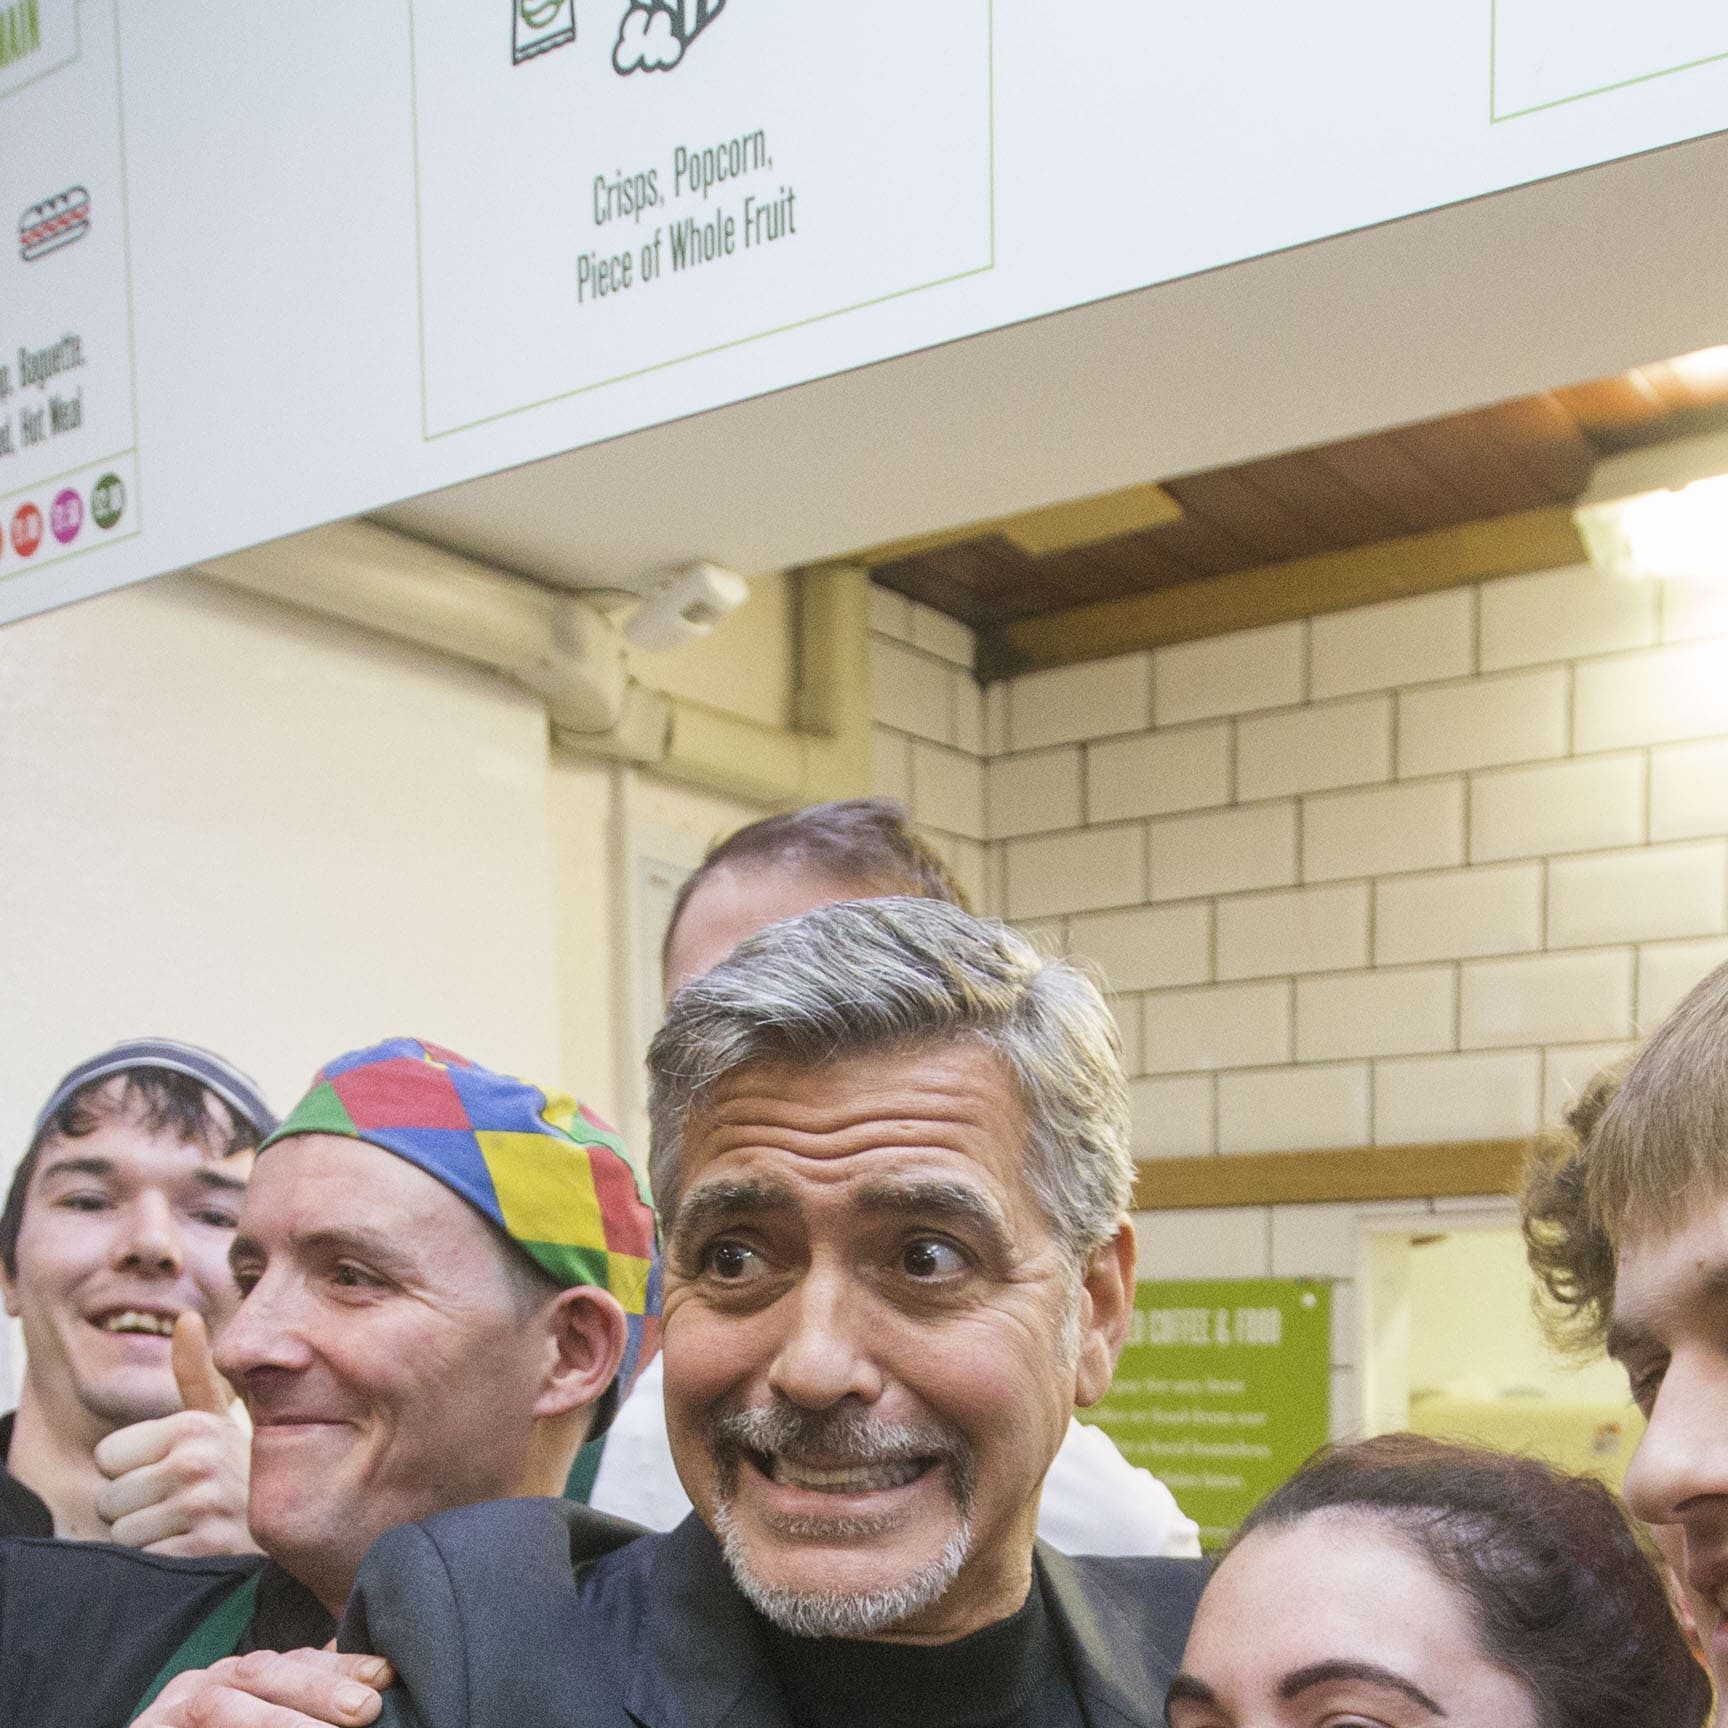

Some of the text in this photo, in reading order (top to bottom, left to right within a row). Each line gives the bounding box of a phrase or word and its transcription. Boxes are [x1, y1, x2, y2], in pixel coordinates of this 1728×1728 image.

[593, 129, 772, 226] Crisps, Popcorn,
[577, 185, 796, 304] Piece of Whole Fruit
